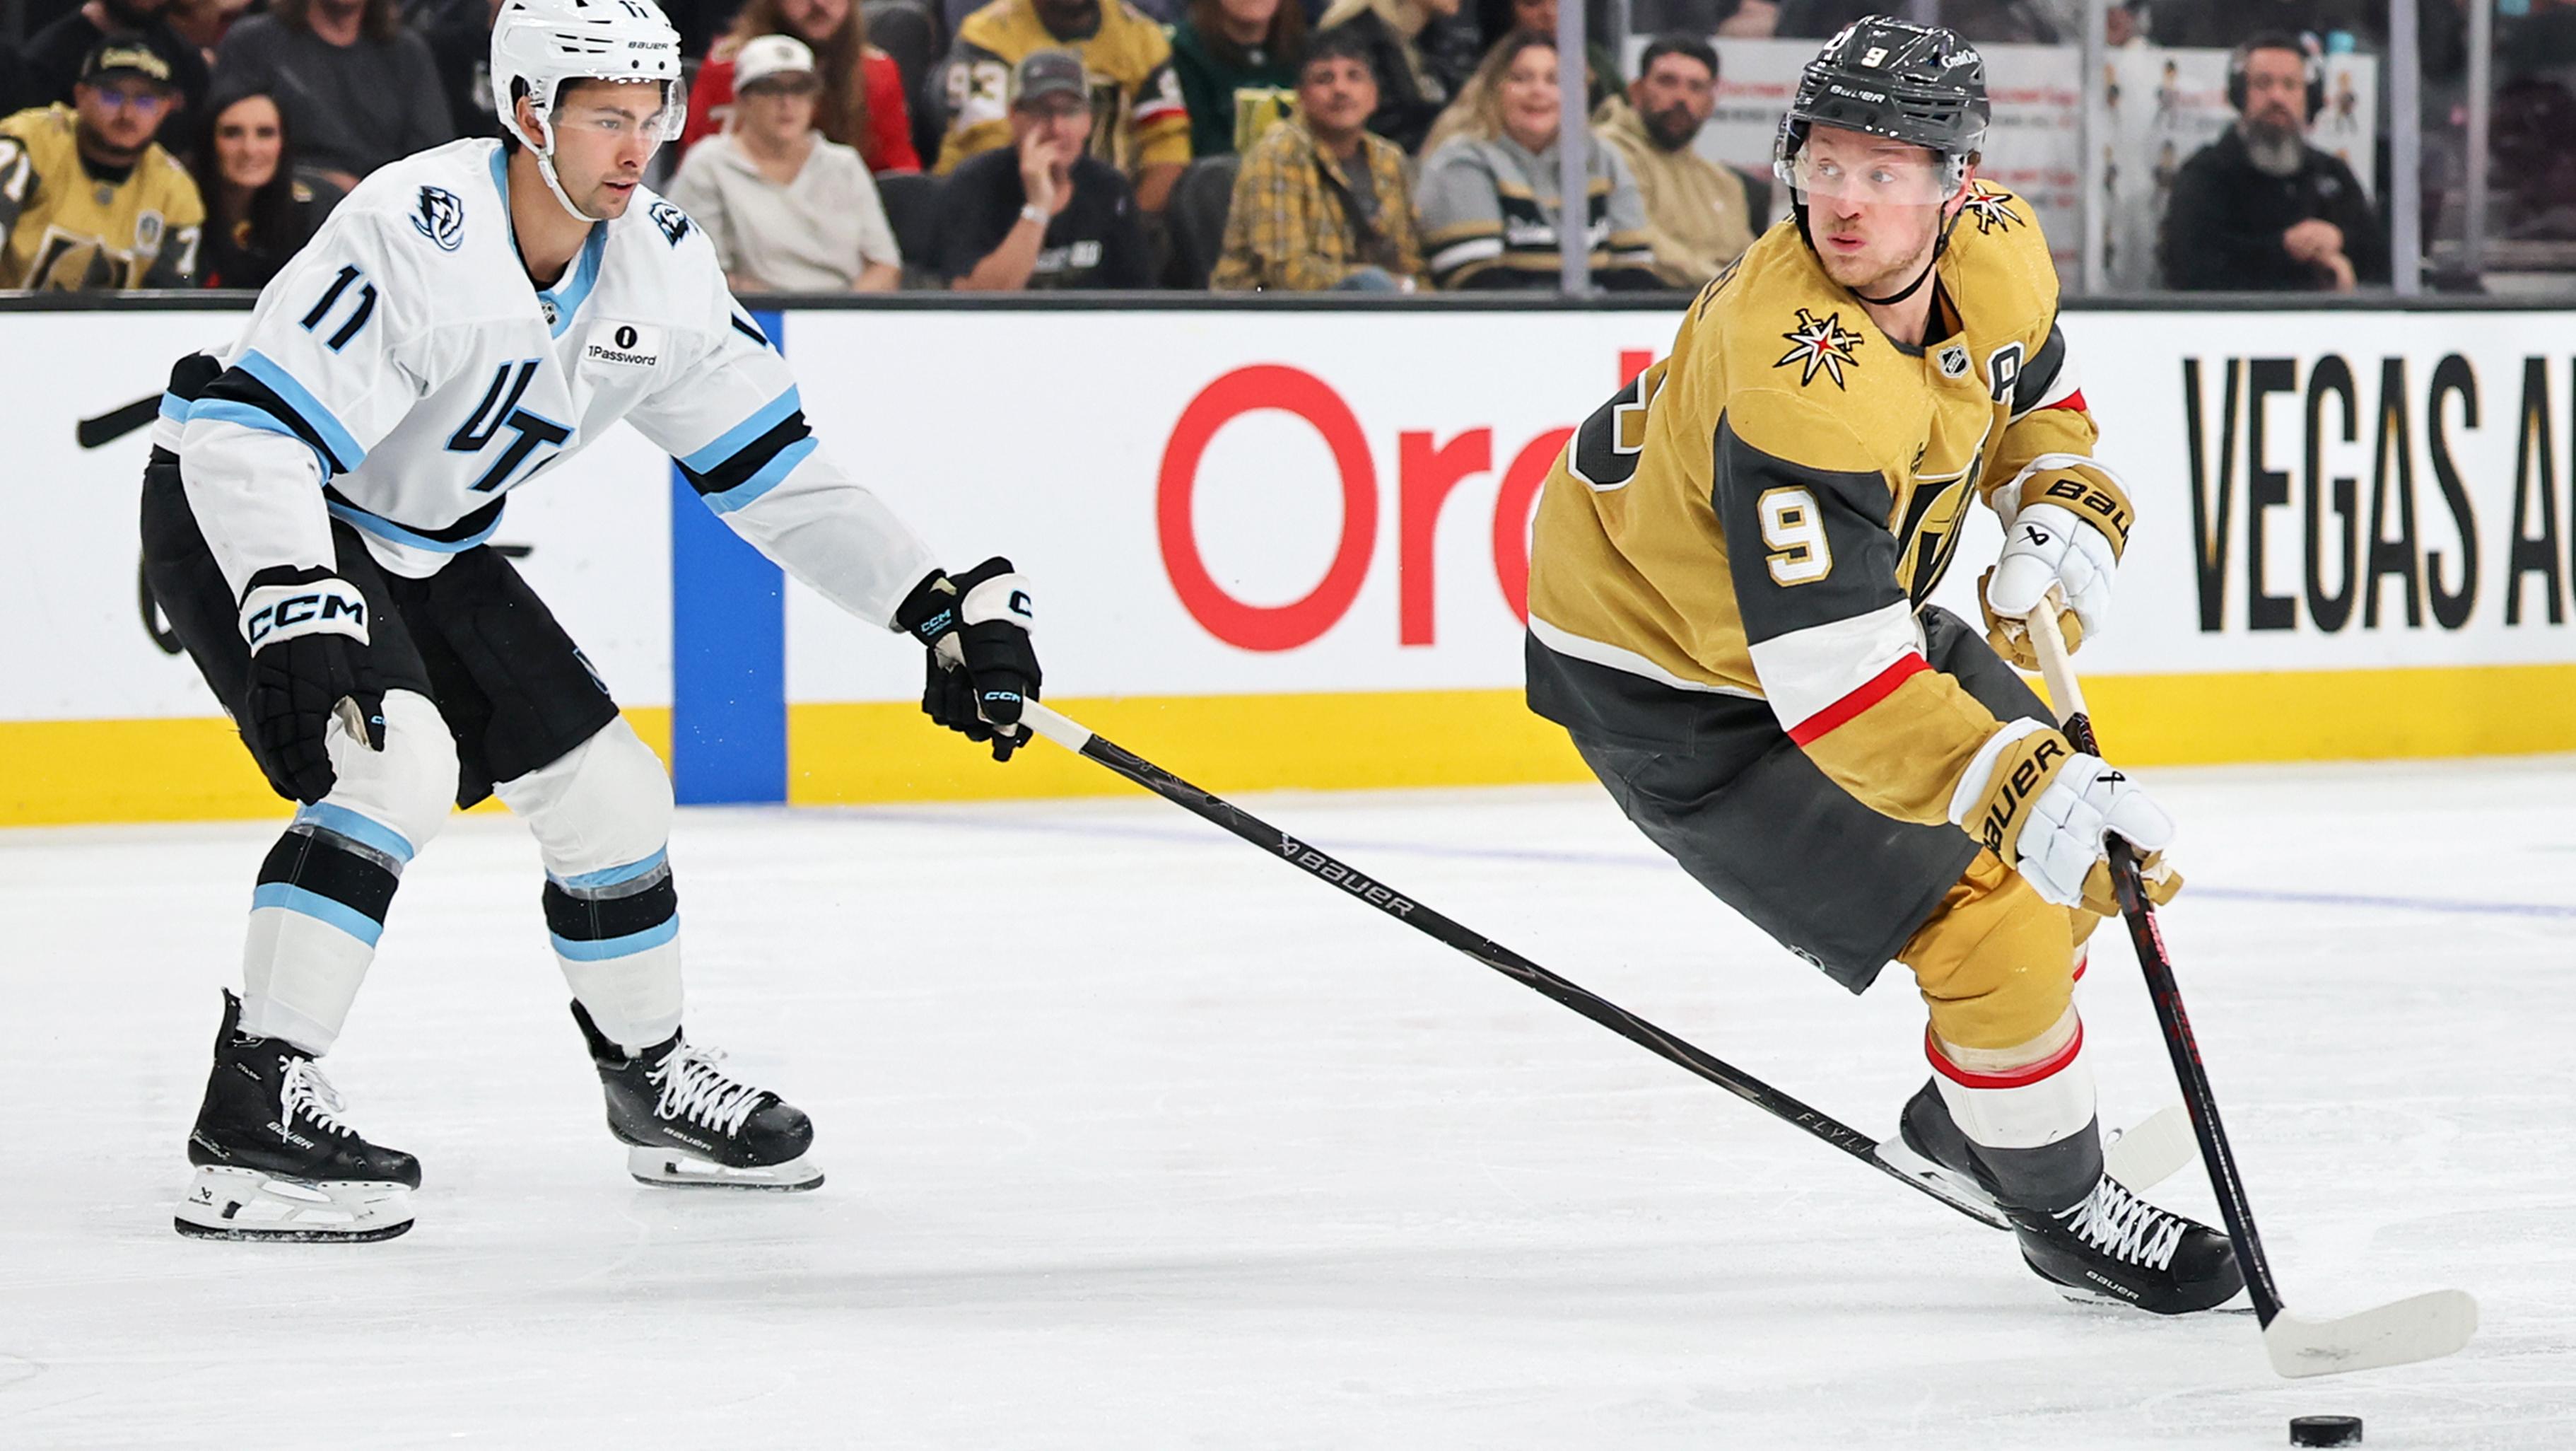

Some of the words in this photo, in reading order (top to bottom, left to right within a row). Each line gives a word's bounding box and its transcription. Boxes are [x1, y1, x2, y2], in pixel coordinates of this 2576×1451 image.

[628, 41, 668, 49] BAUER
[1861, 47, 1889, 68] 9
[1829, 84, 1885, 103] BAUER
[298, 262, 378, 355] 11
[588, 345, 657, 366] 1Password
[1986, 340, 2025, 407] A
[2183, 353, 2479, 633] VEGAS
[2506, 356, 2576, 625] A
[1757, 486, 1832, 588] 9
[2045, 479, 2129, 555] BAU
[248, 593, 363, 645] CCM
[921, 608, 952, 633] CCM
[1298, 851, 1415, 917] BAUER
[663, 1127, 713, 1152] BAUER
[2086, 1271, 2139, 1300] BAUER
